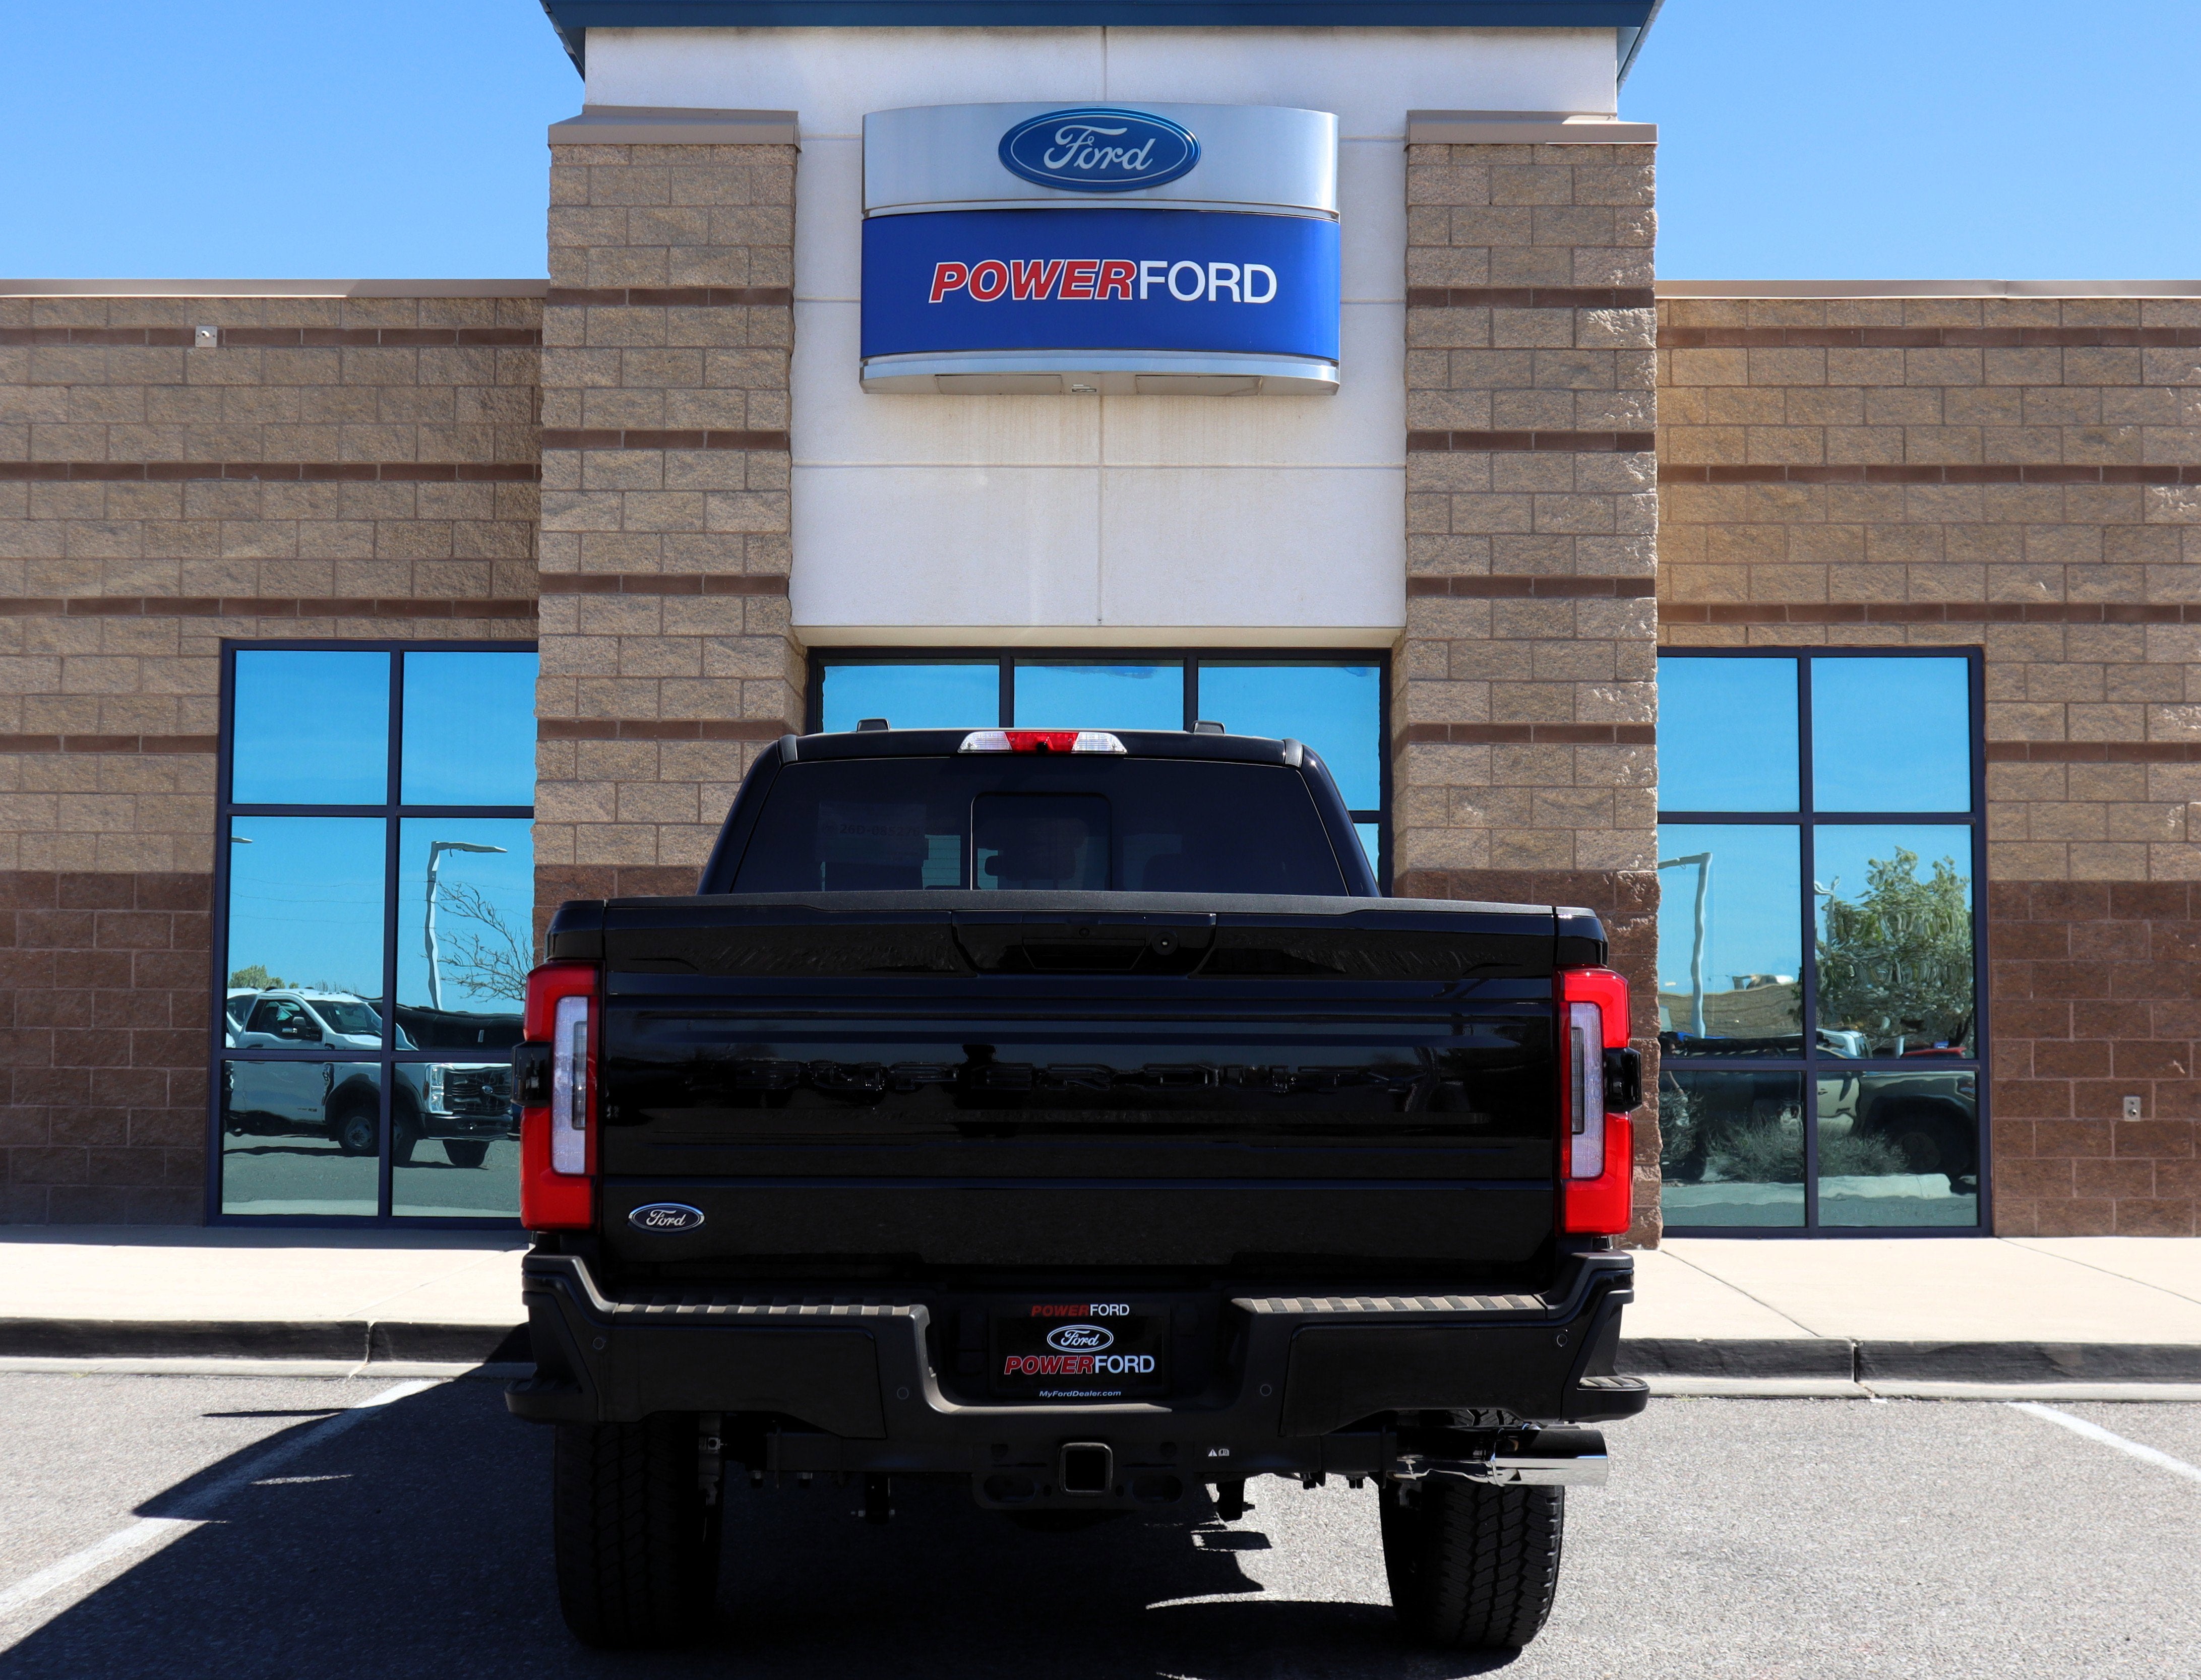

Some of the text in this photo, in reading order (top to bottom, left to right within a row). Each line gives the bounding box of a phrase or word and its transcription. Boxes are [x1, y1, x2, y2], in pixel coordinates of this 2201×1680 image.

[1043, 125, 1156, 170] Ford
[928, 259, 1277, 304] POWERFORD
[645, 1209, 687, 1226] Ford
[1031, 1304, 1130, 1317] POWERFORD
[1060, 1329, 1100, 1347] Ford
[1003, 1354, 1155, 1375] POWERFORD
